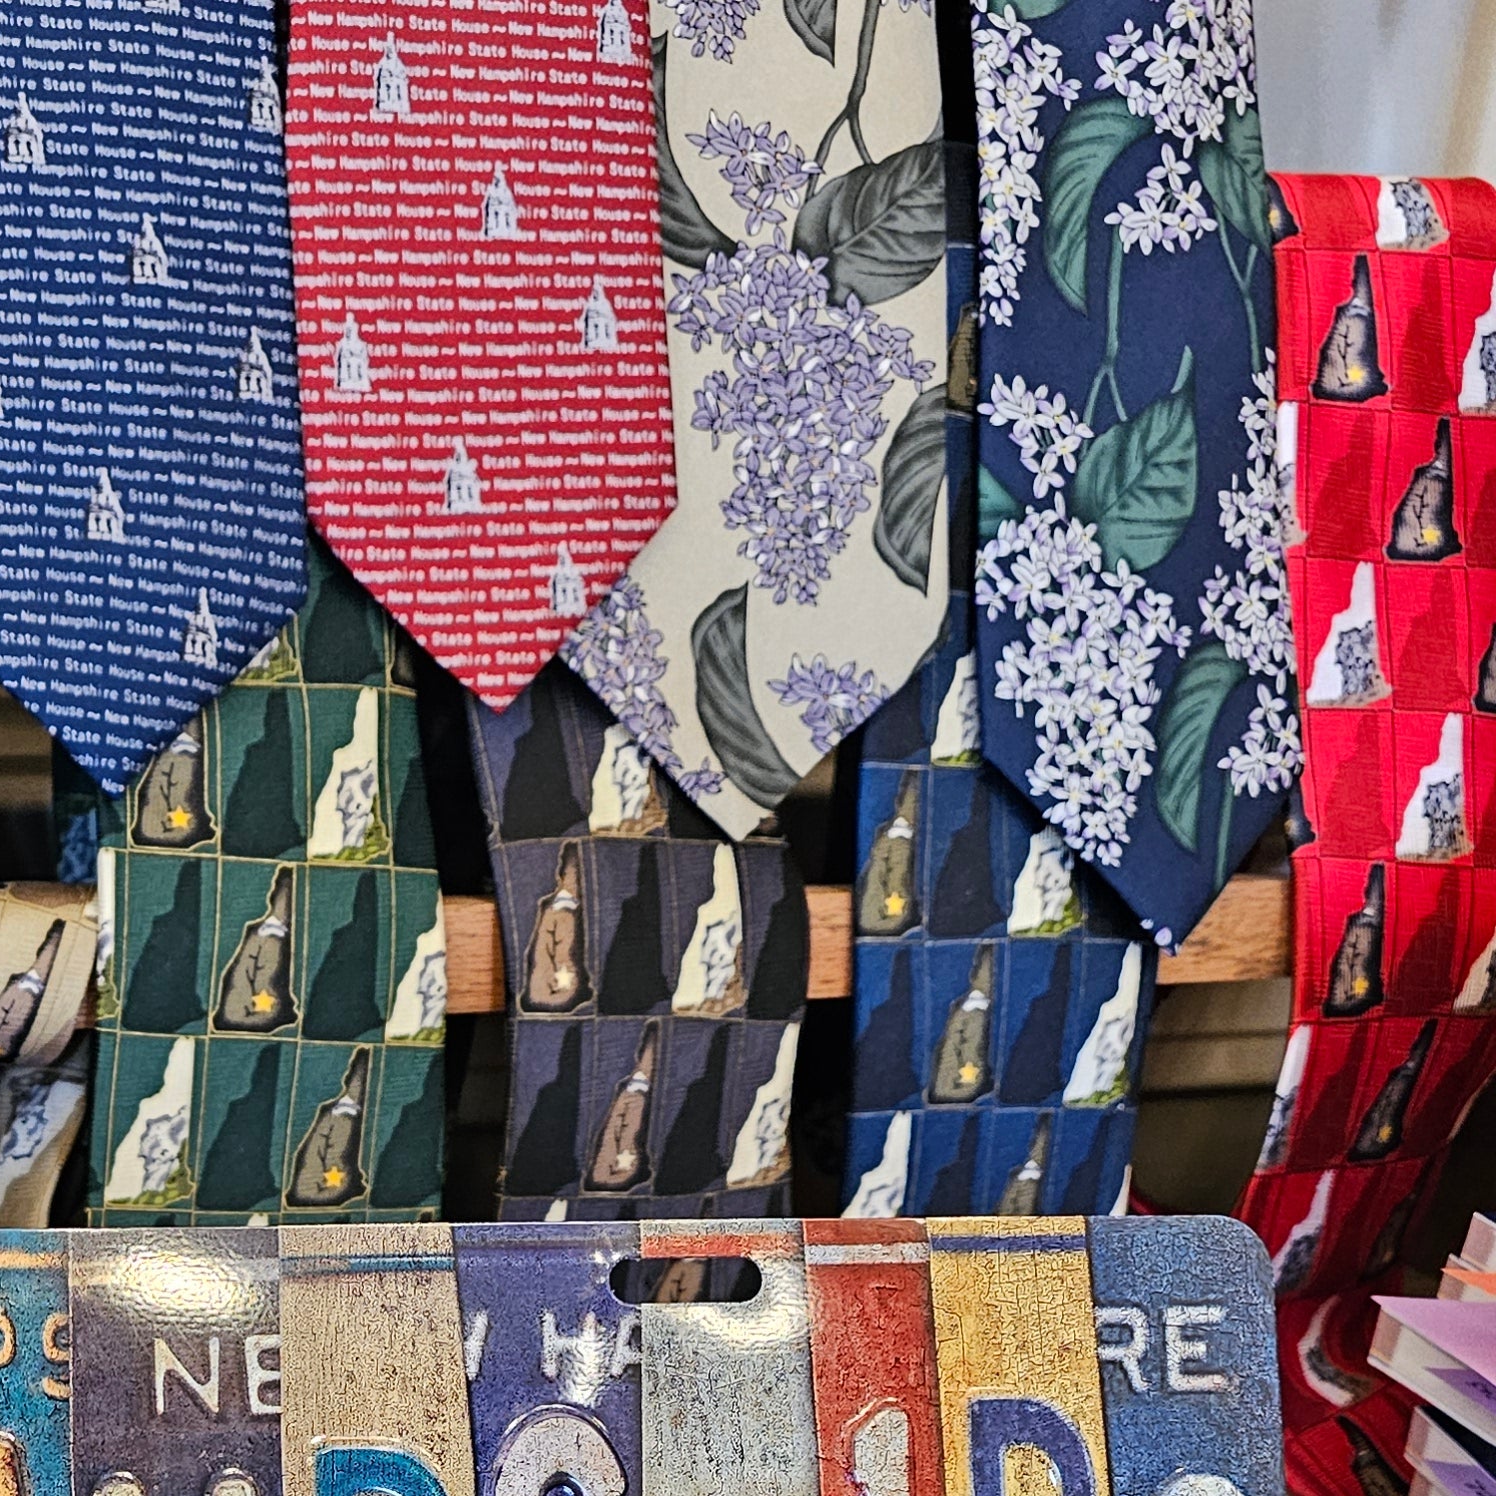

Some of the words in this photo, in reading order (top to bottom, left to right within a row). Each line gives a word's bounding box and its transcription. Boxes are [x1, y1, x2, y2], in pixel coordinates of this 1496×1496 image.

[40, 14, 82, 30] State
[89, 17, 130, 33] House
[152, 21, 178, 37] New
[183, 27, 252, 48] Hampshire
[309, 10, 333, 26] New
[337, 12, 403, 29] Hampshire
[409, 15, 446, 32] State
[452, 18, 489, 34] House
[509, 21, 533, 36] New
[26, 36, 101, 52] Hampshire
[109, 39, 149, 54] State
[156, 44, 194, 61] House
[216, 52, 240, 67] New
[312, 35, 350, 52] House
[469, 42, 506, 58] State
[512, 44, 549, 61] House
[568, 47, 592, 62] New
[23, 56, 64, 71] House
[89, 59, 116, 73] New
[121, 62, 192, 81] Hampshire
[197, 69, 235, 88] State
[450, 64, 475, 79] New
[479, 66, 545, 82] Hampshire
[549, 69, 587, 84] State
[593, 71, 628, 88] House
[43, 77, 85, 93] State
[92, 80, 133, 95] House
[155, 85, 180, 100] New
[410, 84, 448, 101] State
[453, 88, 490, 103] House
[509, 90, 534, 104] New
[537, 91, 604, 108] Hampshire
[610, 94, 644, 112] State
[111, 101, 152, 119] State
[159, 107, 197, 125] House
[218, 115, 243, 130] New
[314, 108, 351, 124] House
[470, 111, 507, 127] State
[513, 114, 550, 128] House
[568, 115, 592, 130] New
[92, 122, 118, 136] New
[123, 125, 195, 144] Hampshire
[200, 132, 238, 150] State
[352, 131, 389, 147] State
[395, 133, 432, 148] House
[452, 134, 476, 148] New
[480, 135, 547, 151] Hampshire
[551, 136, 587, 152] State
[593, 139, 629, 155] House
[47, 139, 88, 156] State
[95, 144, 136, 159] House
[157, 148, 183, 164] New
[188, 153, 258, 173] Hampshire
[311, 154, 336, 170] New
[340, 155, 407, 171] Hampshire
[413, 155, 450, 172] State
[511, 157, 535, 173] New
[539, 160, 604, 176] Hampshire
[610, 161, 646, 178] State
[114, 165, 155, 182] State
[161, 171, 200, 187] House
[315, 179, 353, 195] House
[372, 179, 396, 194] New
[400, 180, 467, 196] Hampshire
[29, 183, 70, 197] House
[95, 186, 121, 201] New
[126, 190, 198, 207] Hampshire
[203, 195, 242, 212] State
[354, 201, 391, 217] State
[397, 203, 434, 218] House
[5, 224, 32, 238] New
[37, 226, 111, 242] Hampshire
[10, 288, 37, 303] New
[41, 291, 115, 307] Hampshire
[121, 292, 161, 309] State
[168, 298, 206, 313] House
[43, 440, 84, 456] House
[108, 444, 134, 459] New
[139, 447, 207, 465] Hampshire
[19, 544, 45, 558] New
[50, 547, 122, 566] Hampshire
[129, 553, 167, 571] State
[173, 560, 209, 578] House
[0, 565, 39, 581] State
[46, 568, 85, 583] House
[109, 573, 133, 589] New
[21, 676, 46, 691] New
[51, 680, 118, 701] Hampshire
[124, 688, 160, 706] State
[63, 725, 100, 745] State
[106, 733, 142, 750] House
